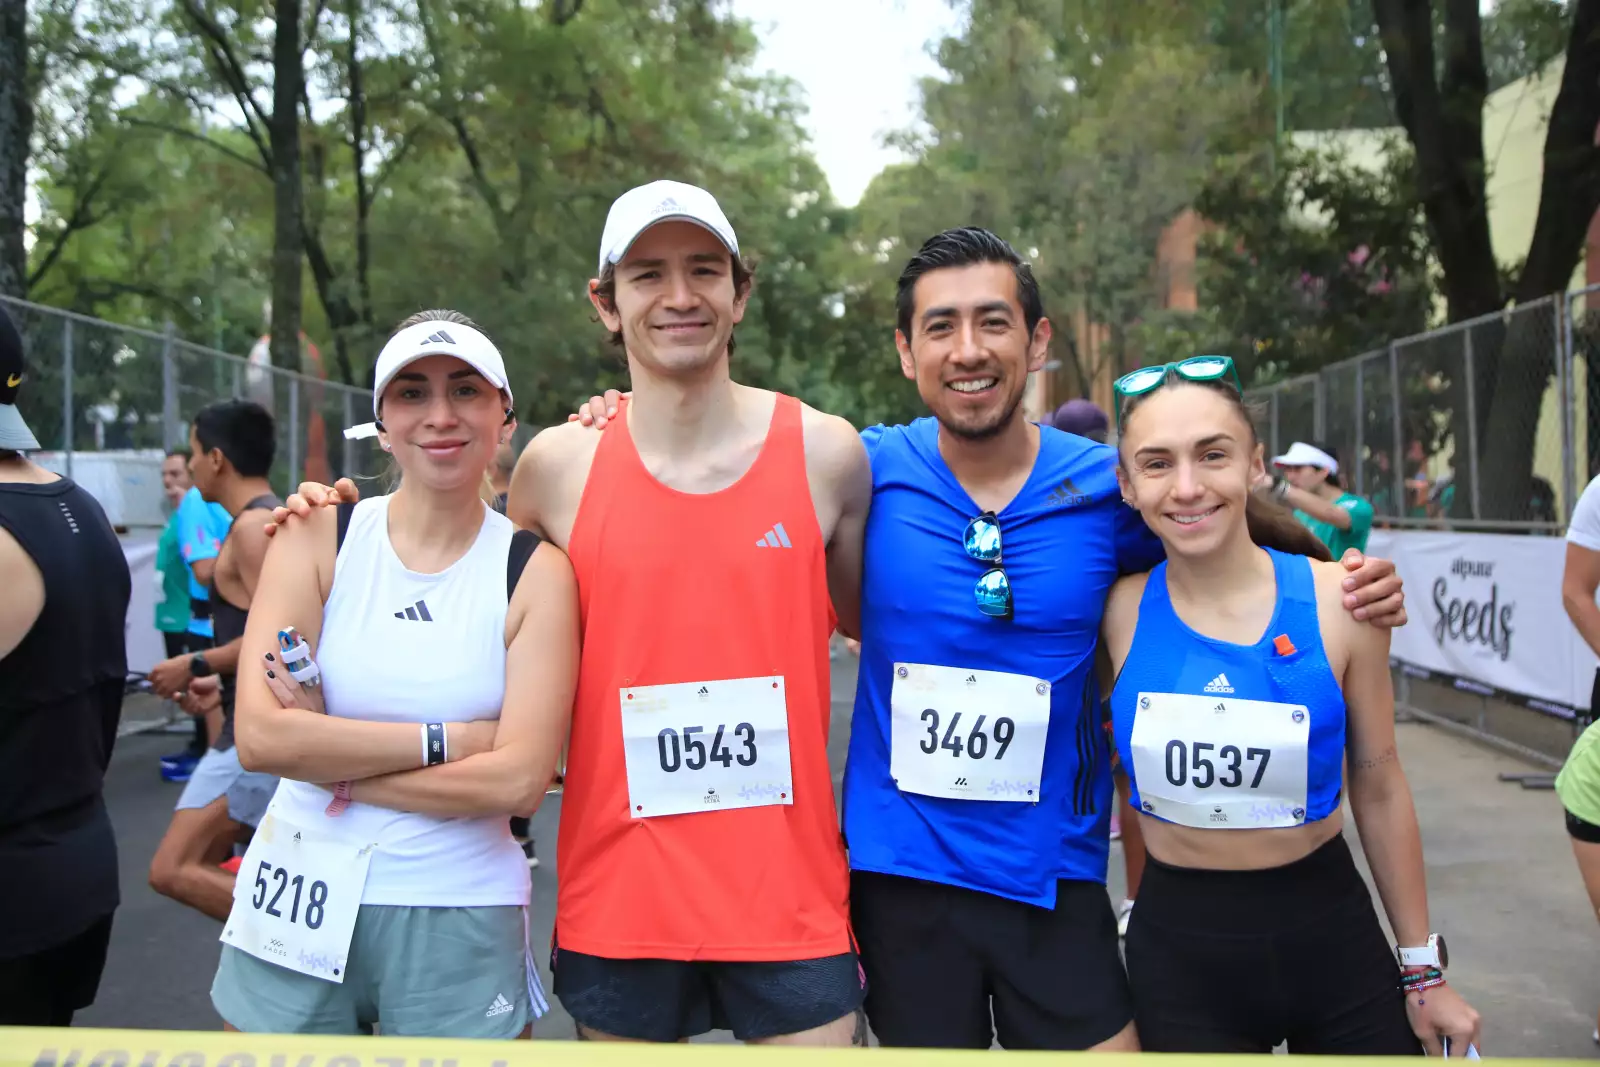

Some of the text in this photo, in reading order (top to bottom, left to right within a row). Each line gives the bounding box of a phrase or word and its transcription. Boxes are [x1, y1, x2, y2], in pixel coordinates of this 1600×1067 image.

[1452, 557, 1492, 580] alpura
[1433, 577, 1513, 662] Seeds
[1203, 685, 1235, 694] adidas
[657, 722, 758, 773] 0543
[919, 708, 1015, 760] 3469
[1165, 739, 1271, 789] 0537
[252, 860, 329, 930] 5218
[485, 1004, 514, 1017] adidas
